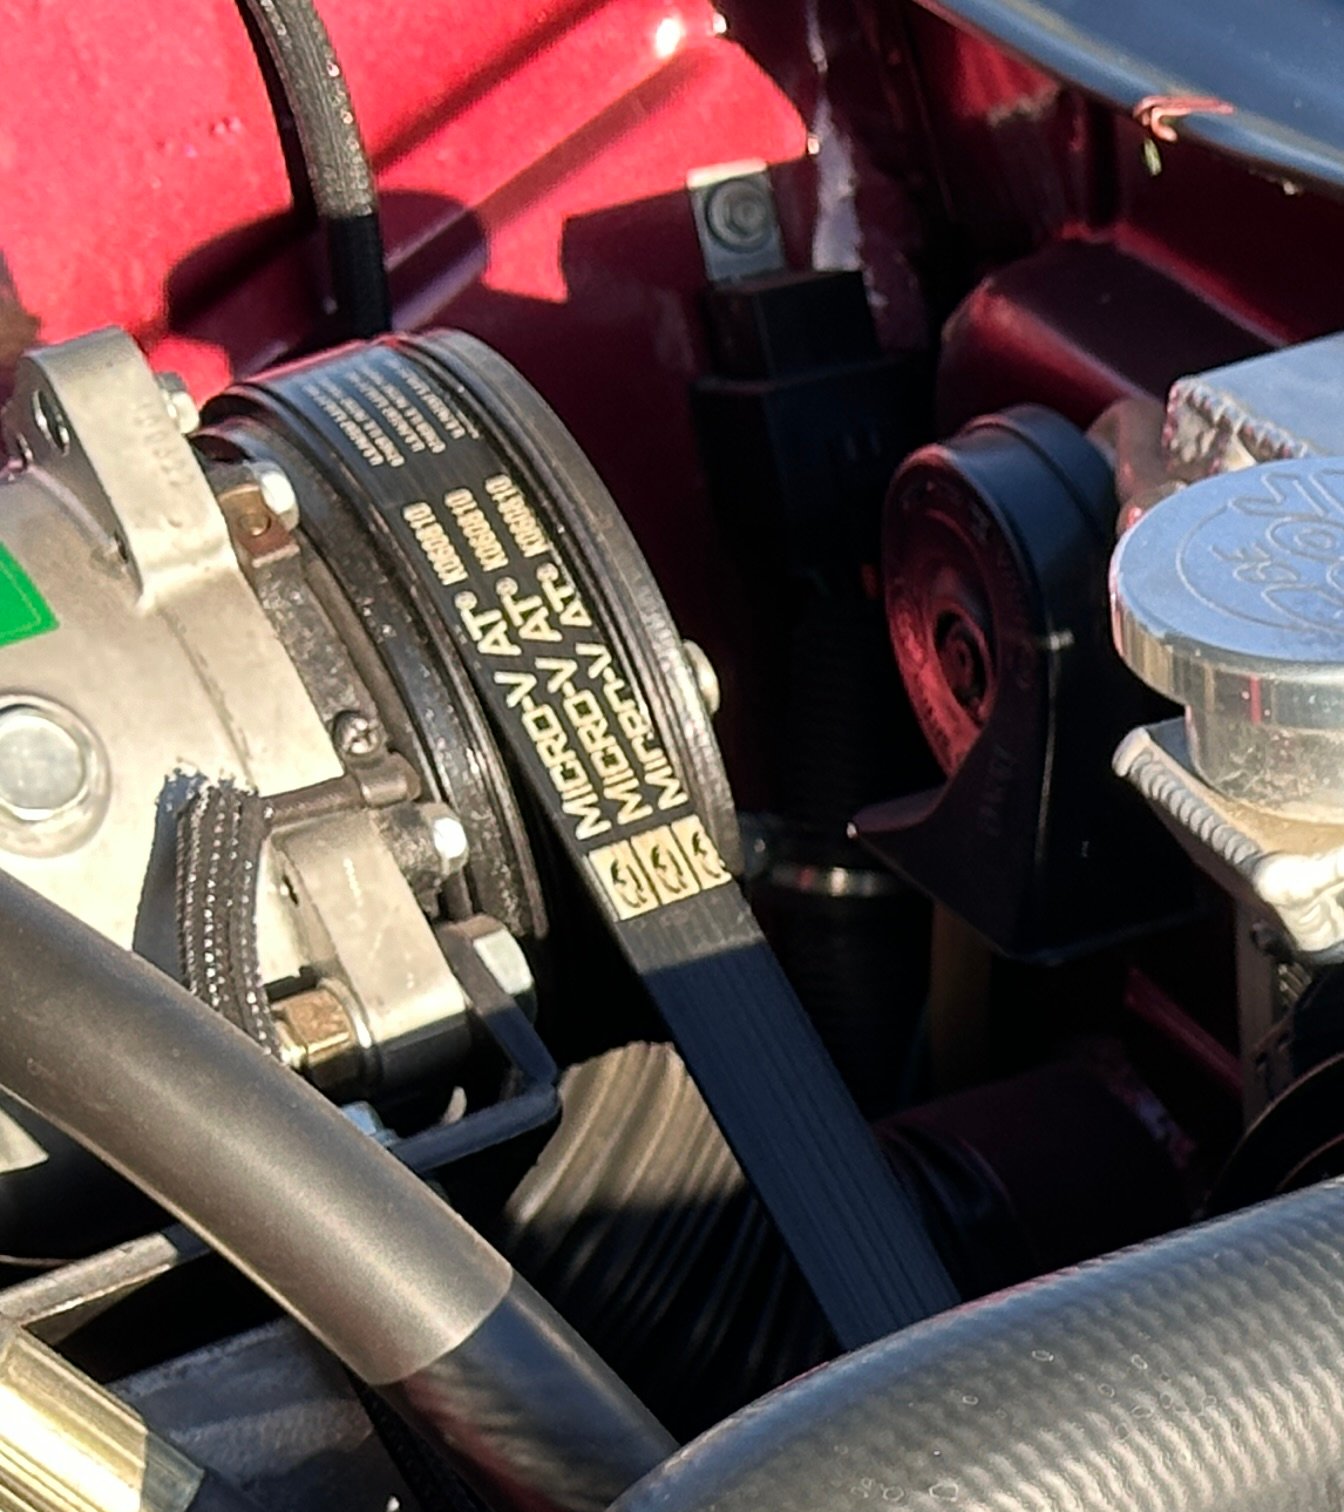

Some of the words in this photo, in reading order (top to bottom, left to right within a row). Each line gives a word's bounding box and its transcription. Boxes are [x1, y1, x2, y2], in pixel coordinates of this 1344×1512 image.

[403, 502, 468, 587] K060810
[443, 488, 509, 574] K060810
[494, 672, 613, 842] MICRO-V
[534, 656, 655, 826] MICRO-V
